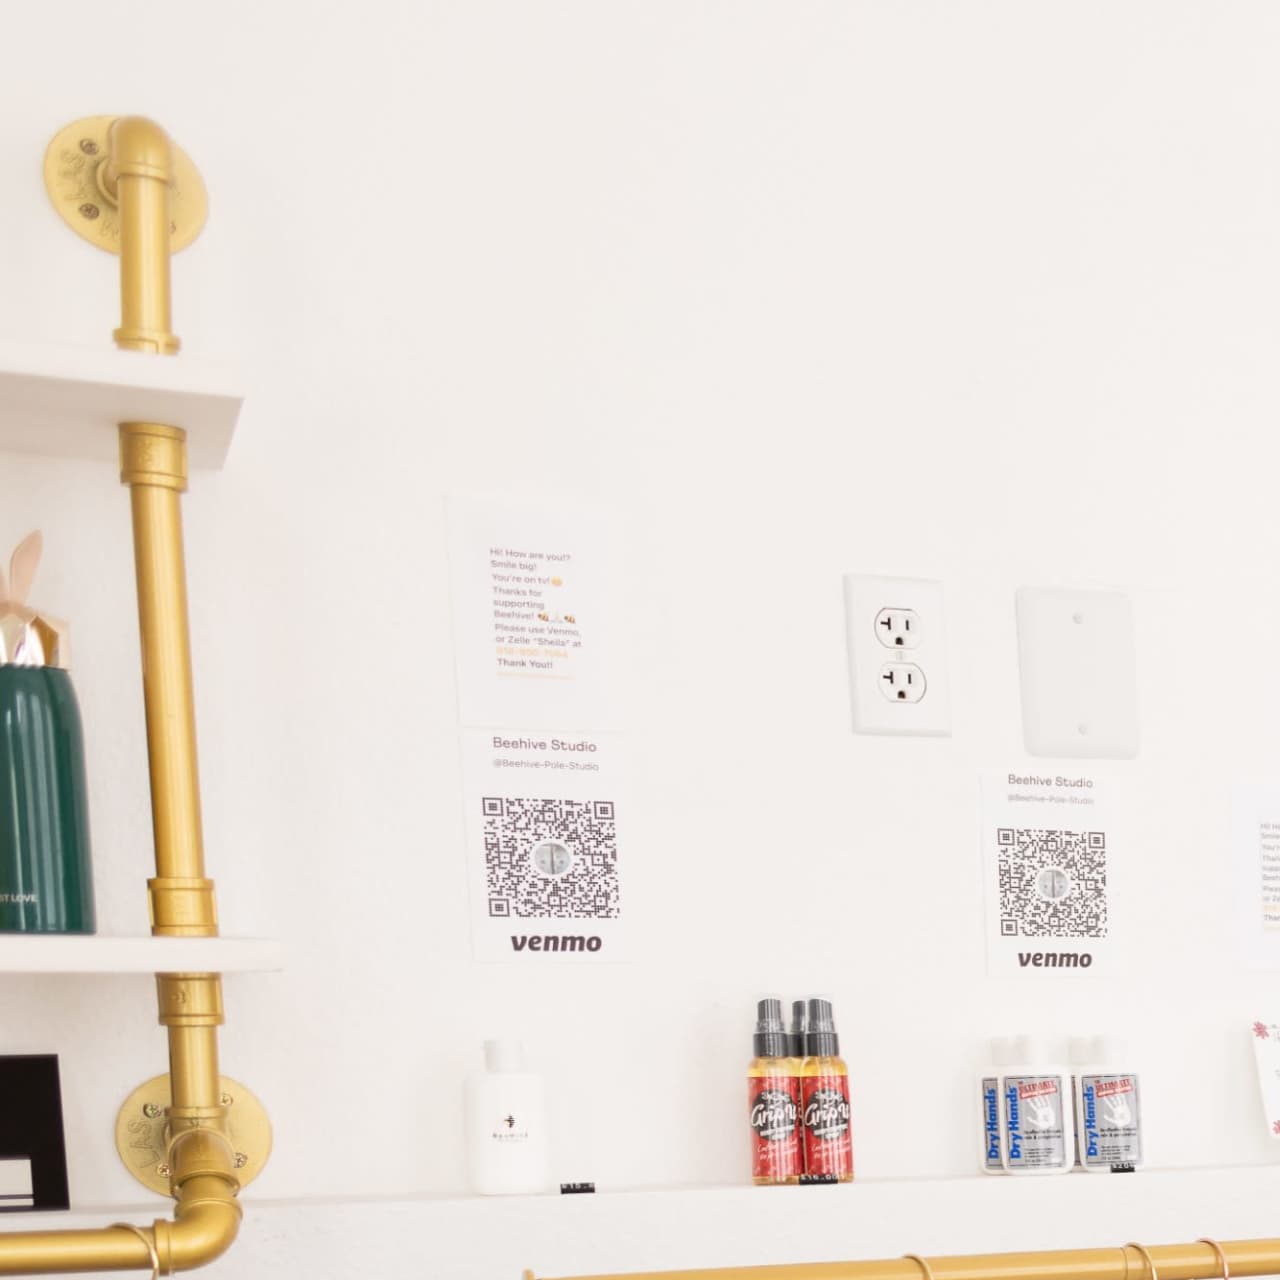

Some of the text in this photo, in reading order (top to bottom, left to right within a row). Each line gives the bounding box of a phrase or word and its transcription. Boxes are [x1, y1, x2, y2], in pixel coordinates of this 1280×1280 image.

[505, 549, 528, 559] How
[490, 560, 517, 569] Smile
[493, 586, 542, 598] Thanks for
[493, 600, 545, 610] supporting
[495, 623, 526, 633] Please
[507, 636, 530, 645] Zelle
[572, 640, 582, 648] at
[497, 658, 527, 668] Thank
[493, 736, 598, 753] Beehive Studio
[1008, 773, 1094, 788] Beehive Studio
[510, 934, 603, 952] venmo
[1018, 952, 1094, 968] venmo
[984, 1087, 1000, 1132] Hands
[1005, 1085, 1024, 1160] Dry Hands
[1083, 1085, 1101, 1157] Dry Hands
